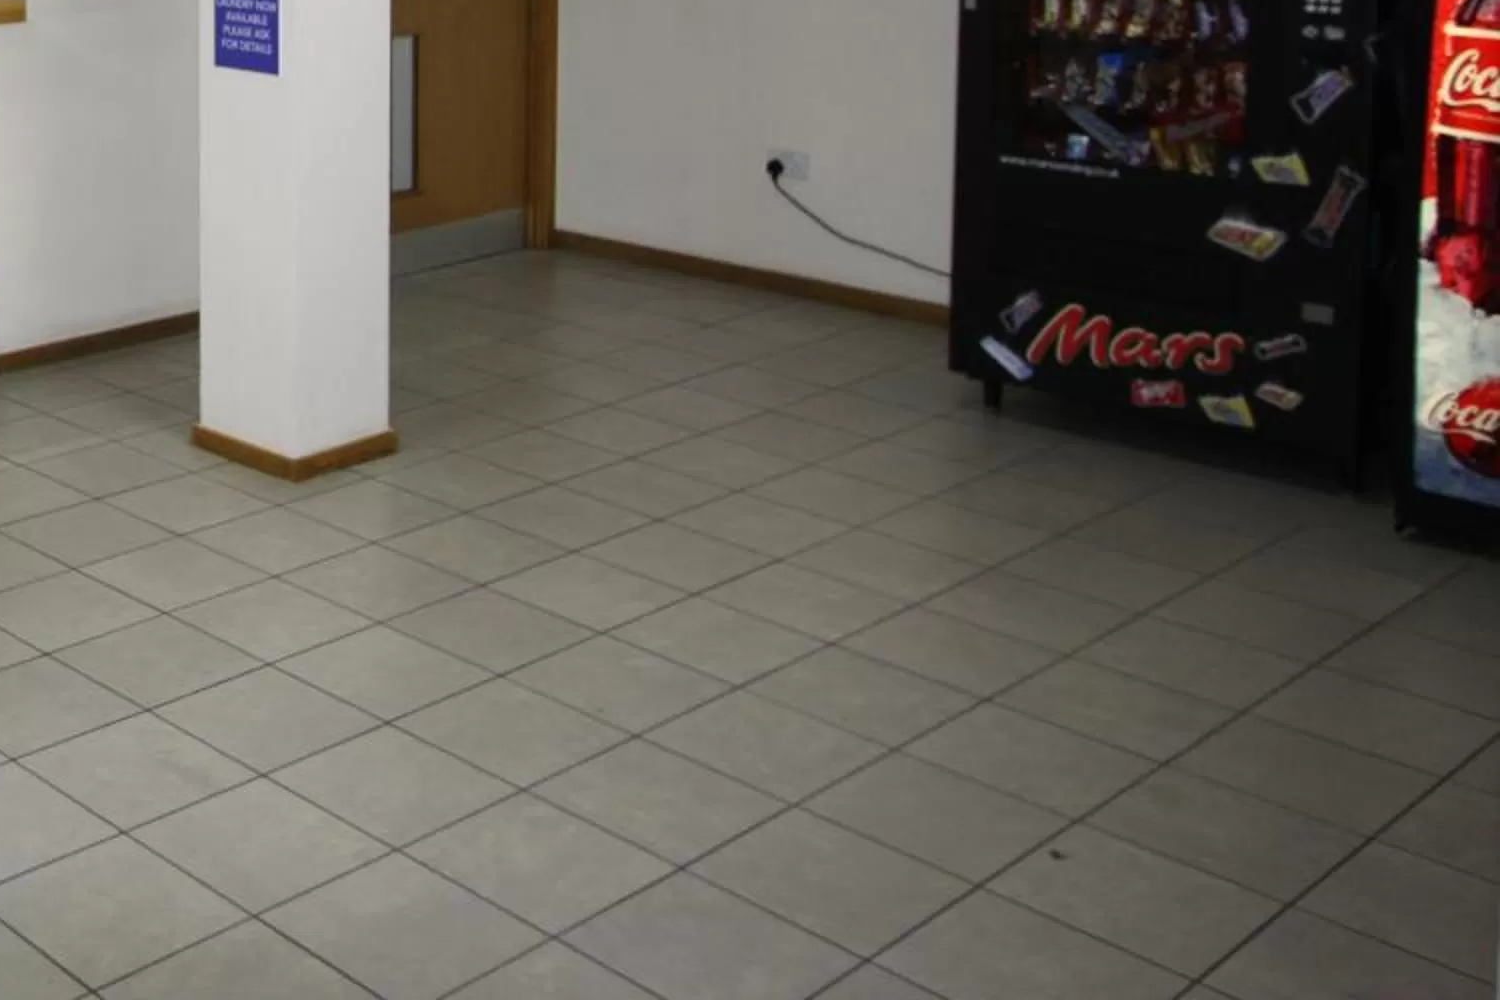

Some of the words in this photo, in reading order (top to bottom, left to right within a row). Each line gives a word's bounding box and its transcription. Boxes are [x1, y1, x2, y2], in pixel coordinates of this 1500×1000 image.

[225, 11, 268, 27] AVAILABLE
[222, 24, 252, 38] PLEASE
[221, 37, 238, 49] FOR
[239, 40, 272, 55] DETAILS
[1026, 303, 1245, 374] Mars
